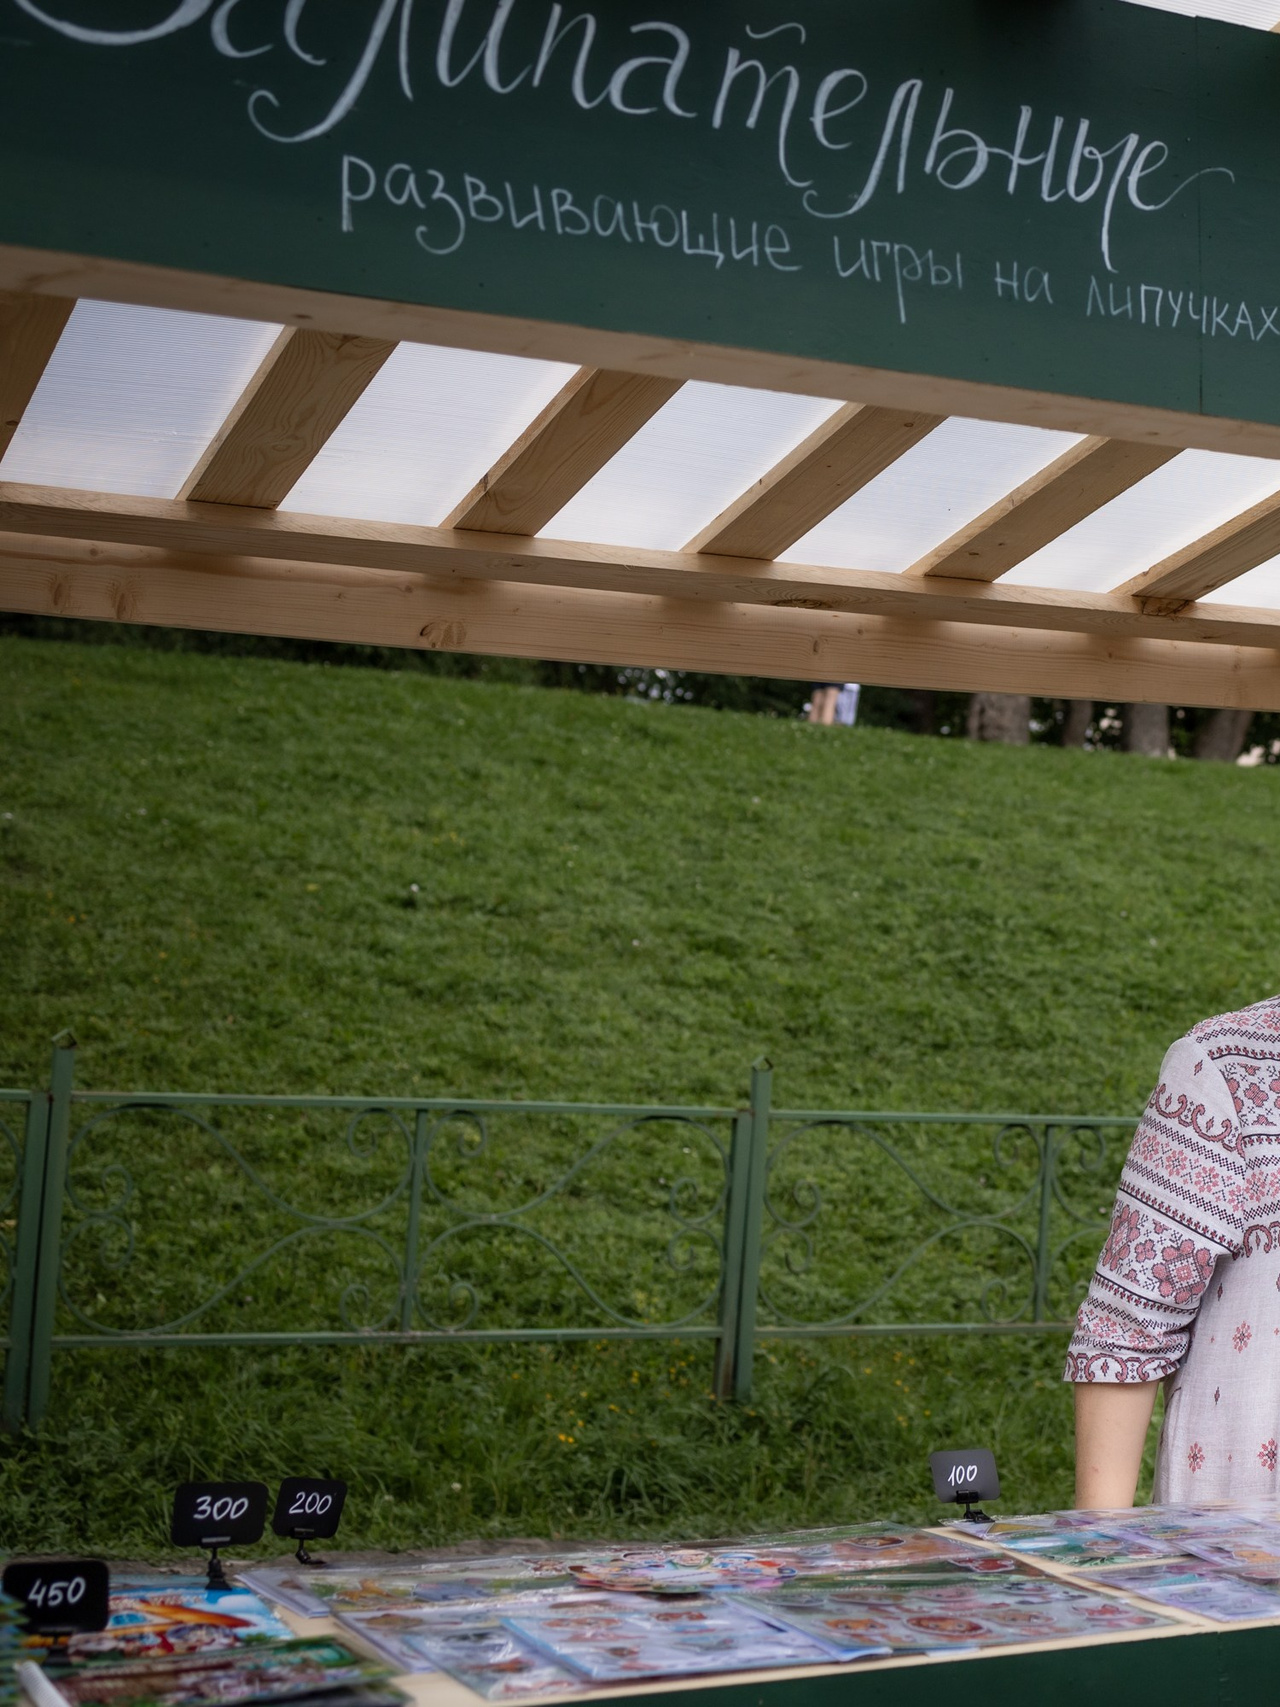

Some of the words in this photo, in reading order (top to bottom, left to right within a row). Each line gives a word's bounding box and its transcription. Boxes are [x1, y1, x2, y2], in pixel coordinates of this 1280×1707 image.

[341, 155, 803, 270] развивающие
[833, 234, 963, 323] игры
[994, 260, 1053, 304] на
[947, 1464, 978, 1487] 100
[193, 1494, 249, 1521] 300
[288, 1491, 332, 1516] 200
[27, 1576, 87, 1607] 450
